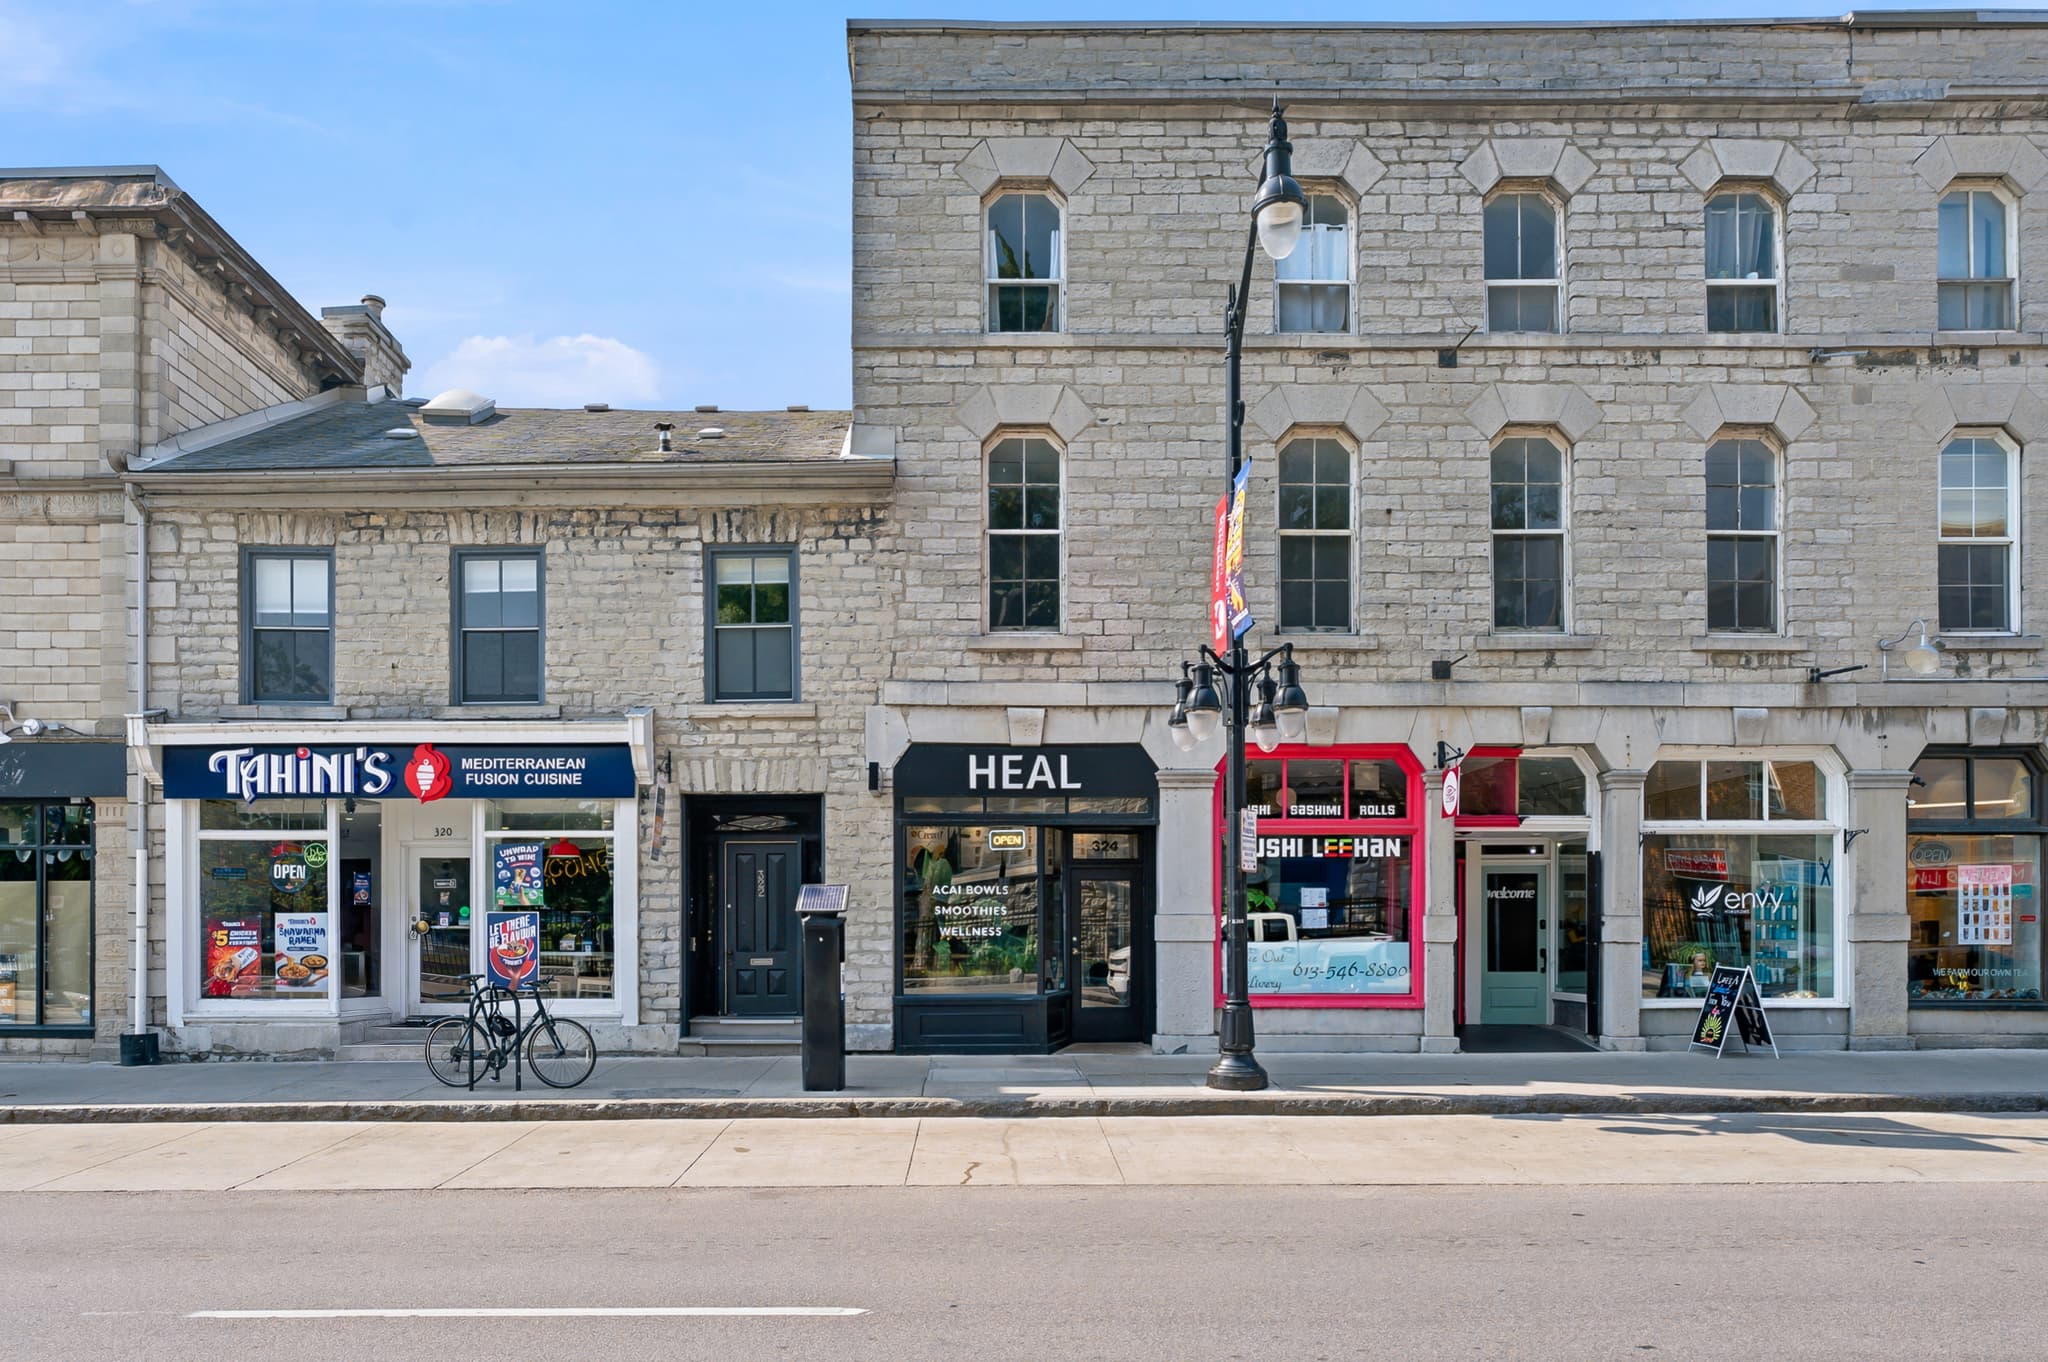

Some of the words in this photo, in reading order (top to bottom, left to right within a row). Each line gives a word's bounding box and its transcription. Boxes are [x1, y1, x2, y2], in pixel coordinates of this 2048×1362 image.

[461, 757, 586, 770] MEDITERRANEAN
[969, 754, 1082, 790] HEAL
[465, 773, 519, 785] FUSION
[524, 773, 582, 785] CUISINE
[1359, 804, 1396, 816] ROLLS
[433, 827, 453, 837] 320
[992, 835, 1022, 846] OPEN
[1091, 840, 1120, 852] 324
[1914, 848, 1950, 862] OPEN
[273, 864, 306, 879] OPEN
[932, 885, 962, 895] ACAI
[966, 885, 1009, 895] BOWLS
[1723, 892, 1785, 914] envy
[934, 905, 1008, 916] SMOOTHIES
[938, 926, 1003, 937] WELLNESS
[288, 936, 317, 946] RAMEN
[1292, 961, 1408, 981] 613-546-8800
[1970, 968, 1990, 977] OUR
